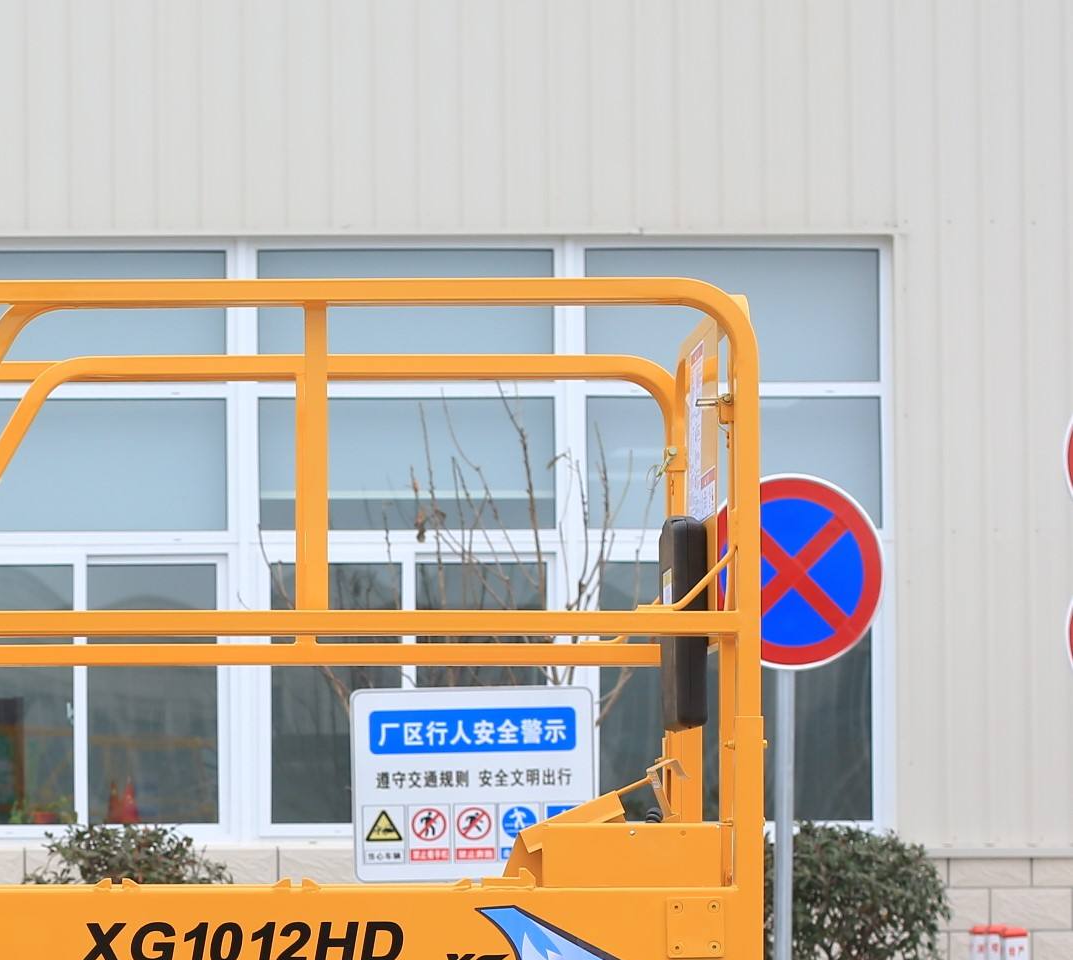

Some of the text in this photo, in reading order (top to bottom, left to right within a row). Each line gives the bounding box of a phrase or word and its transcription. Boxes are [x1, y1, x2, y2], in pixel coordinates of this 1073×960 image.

[378, 718, 567, 747] 厂区行人安全警示
[376, 768, 572, 789] 遵守交通规则 安全文明出行
